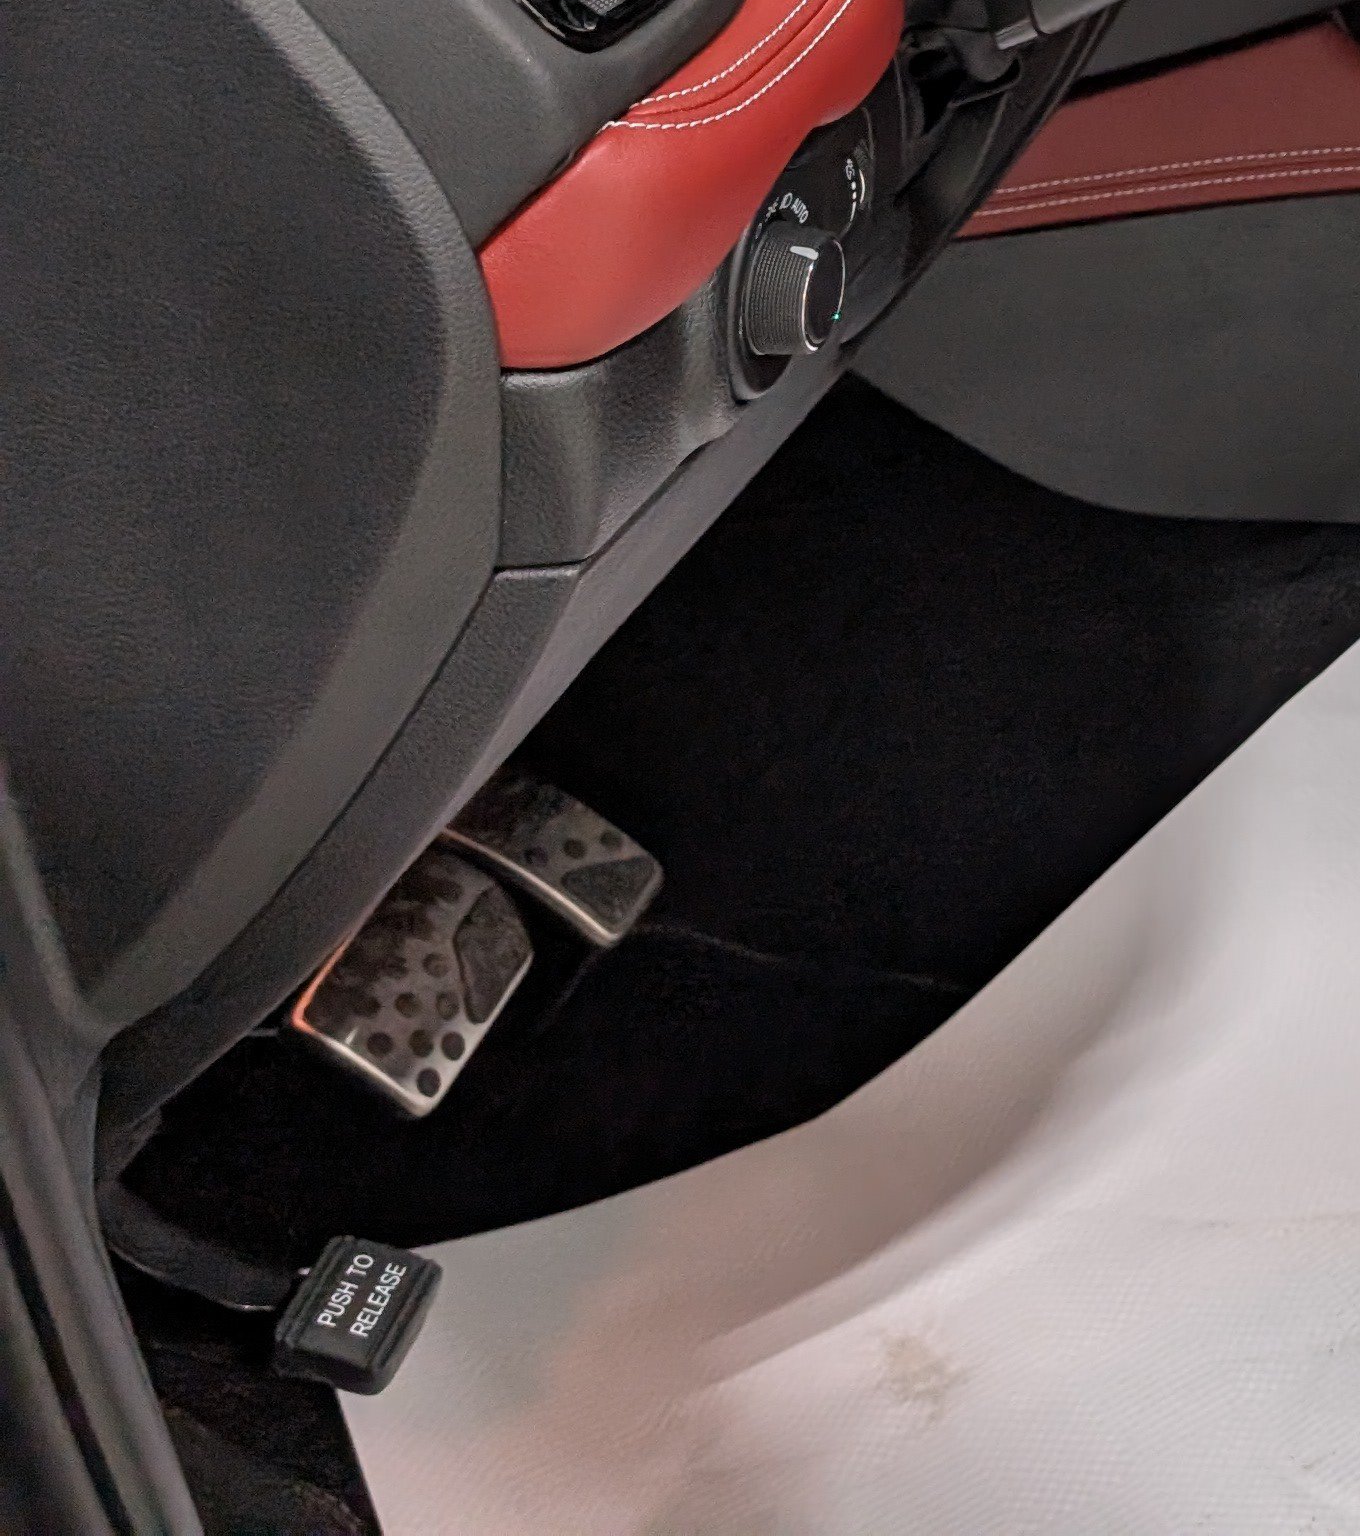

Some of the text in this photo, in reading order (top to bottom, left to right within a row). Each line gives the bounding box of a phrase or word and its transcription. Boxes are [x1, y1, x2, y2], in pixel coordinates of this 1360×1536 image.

[791, 198, 809, 223] AUTO
[317, 1254, 375, 1328] PUSH TO
[350, 1263, 407, 1337] RELEASE
